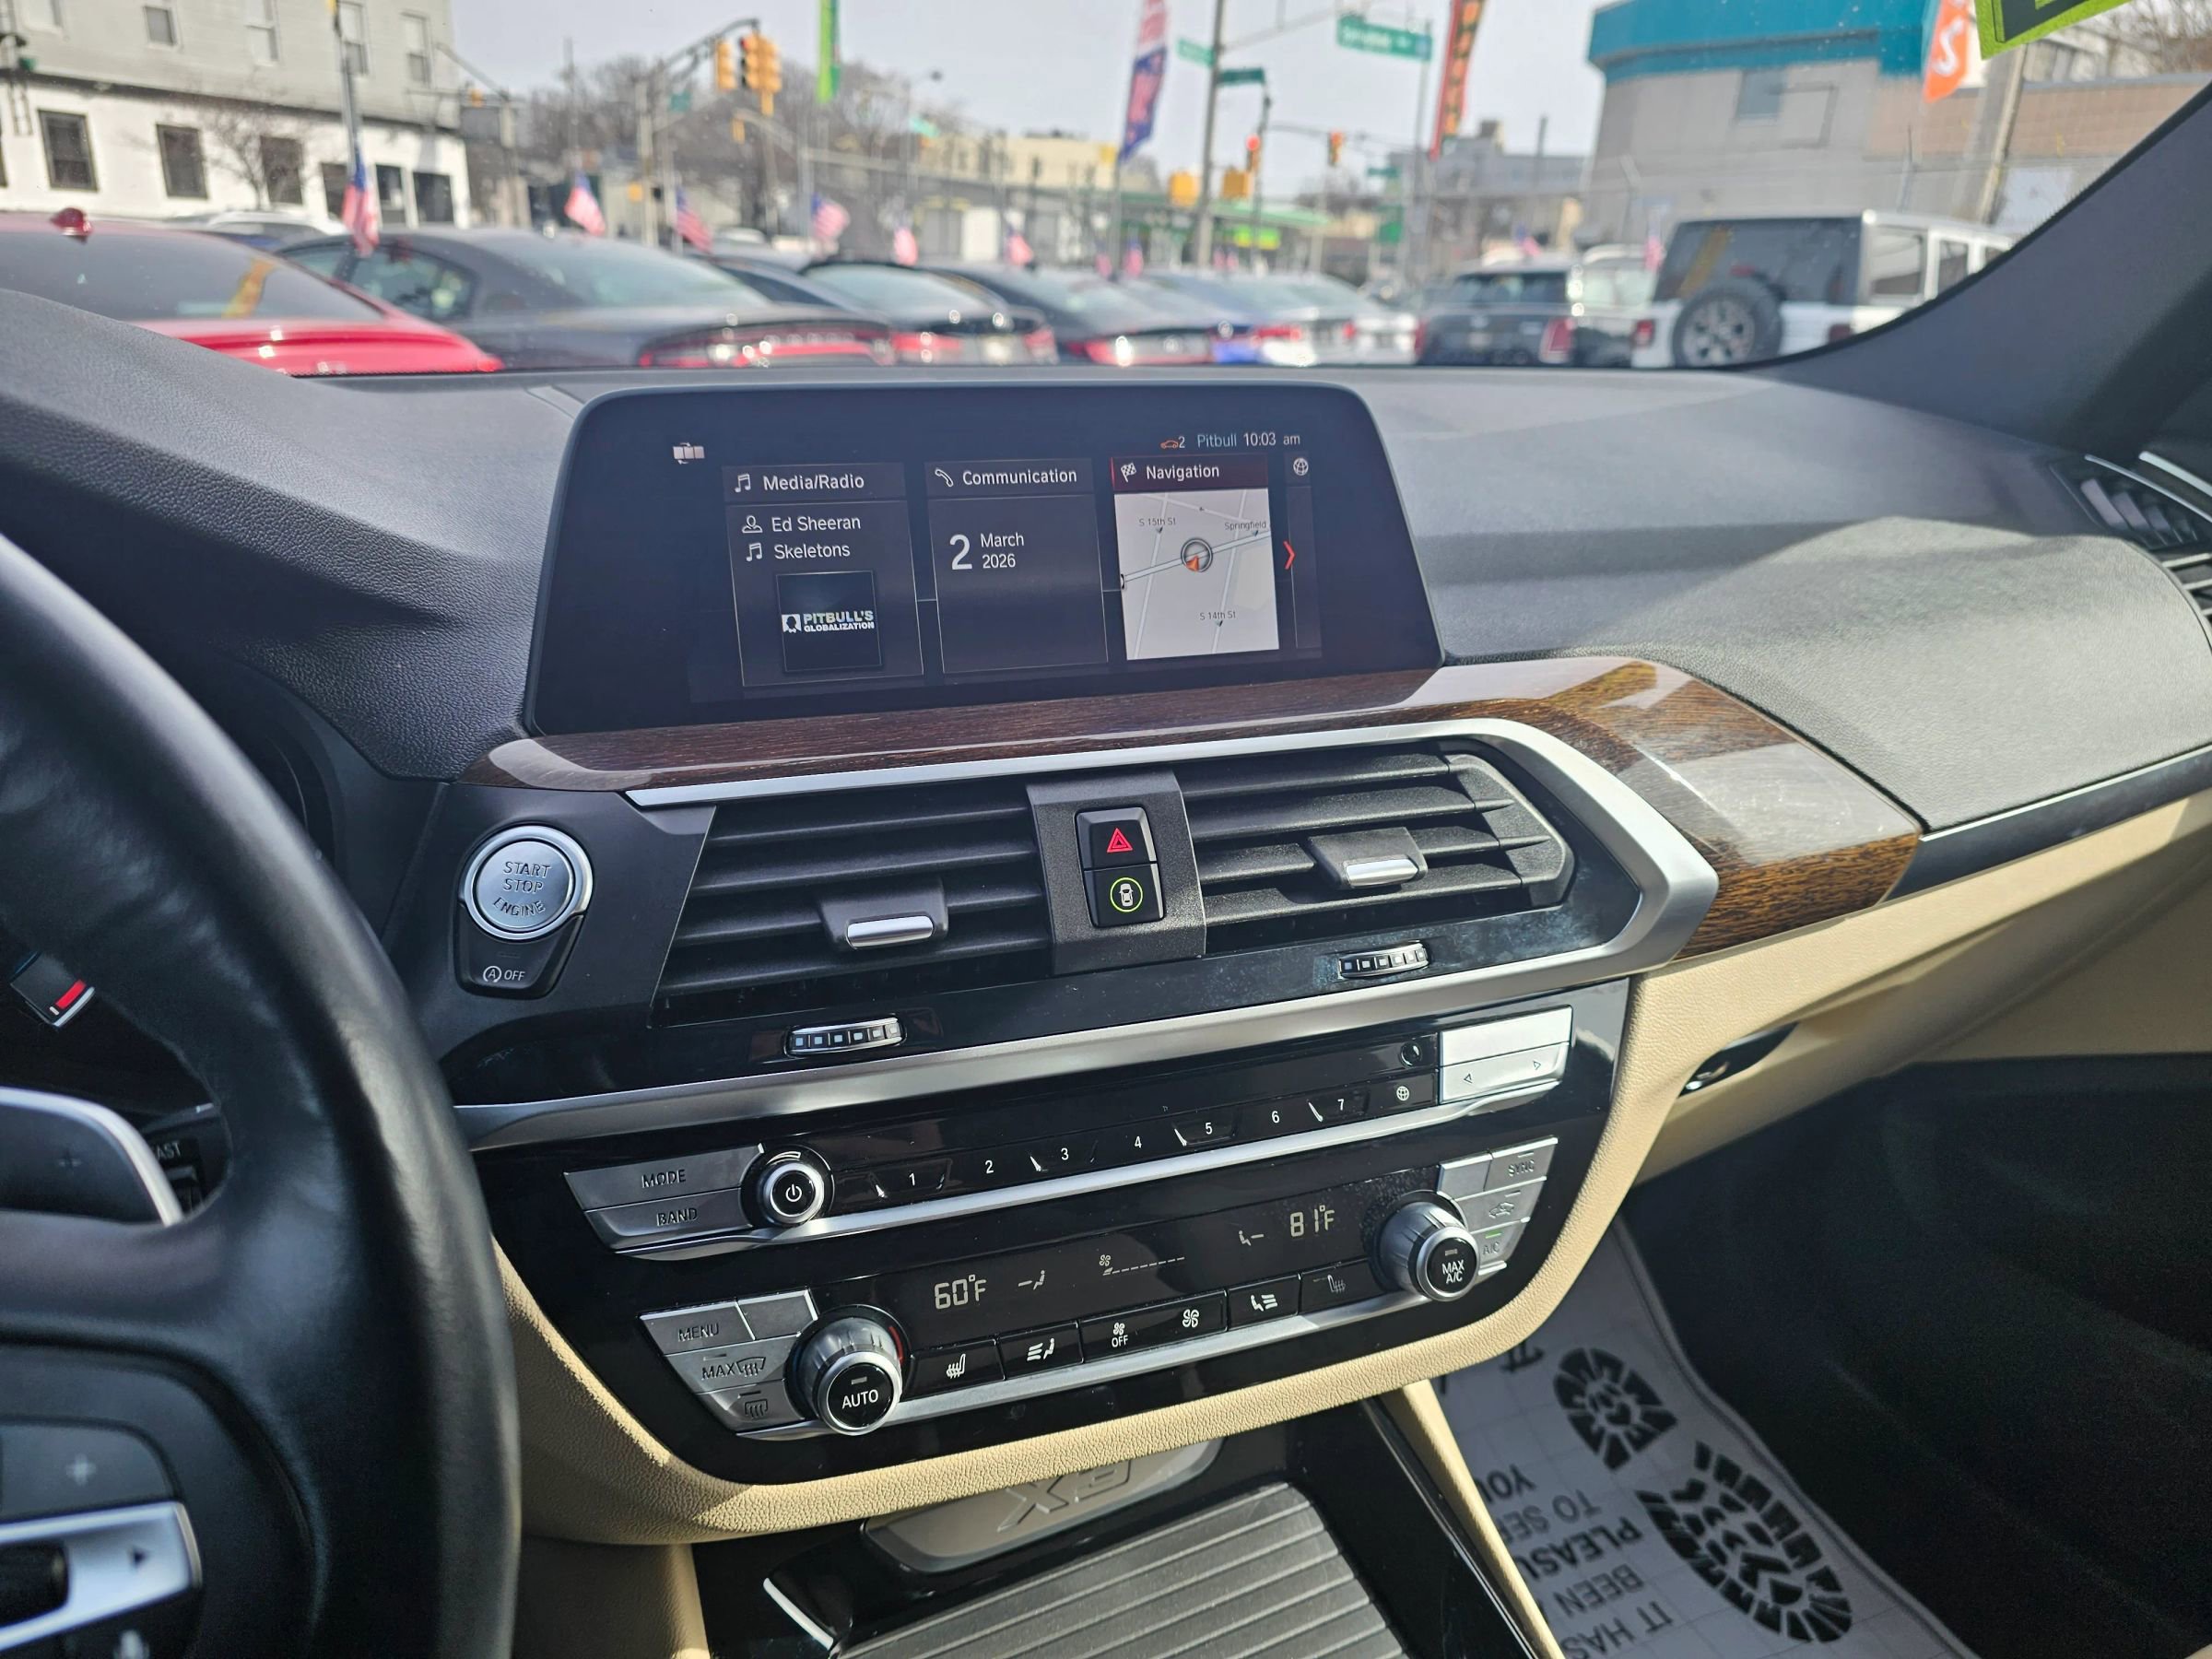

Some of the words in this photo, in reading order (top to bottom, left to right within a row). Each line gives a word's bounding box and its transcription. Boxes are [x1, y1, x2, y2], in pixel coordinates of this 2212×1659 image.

[1178, 436, 1186, 449] 2
[1197, 433, 1238, 448] Pitbull
[1243, 432, 1277, 447] 10:03
[1283, 434, 1301, 445] am
[763, 473, 865, 491] Media/Radio
[962, 468, 1077, 486] Communication
[1146, 465, 1219, 482] Navigation
[771, 517, 793, 532] Ed
[797, 515, 861, 532] Sheeran
[1138, 518, 1145, 527] S
[1147, 517, 1166, 527] 15th
[1168, 517, 1176, 526] St
[1224, 520, 1267, 531] Springfield
[980, 531, 1025, 547] March
[773, 542, 851, 559] Skeletons
[949, 534, 973, 571] 2
[982, 553, 1016, 569] 2026
[803, 610, 874, 624] PITBULL'S
[1199, 612, 1206, 620] S
[1208, 611, 1226, 620] 14th
[1228, 610, 1236, 619] St
[804, 621, 875, 632] GLOBALIZATION
[503, 861, 551, 878] START
[502, 878, 544, 894] STOP
[492, 897, 547, 917] ENGINE
[503, 970, 525, 982] OFF
[152, 1140, 182, 1160] AST
[908, 1172, 916, 1186] 1
[984, 1159, 994, 1174] 2
[1060, 1147, 1069, 1161] 3
[1134, 1135, 1143, 1149] 4
[1205, 1122, 1213, 1135] 5
[1271, 1110, 1280, 1124] 6
[1337, 1099, 1346, 1112] 7
[641, 1169, 687, 1189] MODE
[656, 1207, 698, 1227] BAND
[1483, 1241, 1500, 1256] A/C
[1441, 1259, 1465, 1275] MAX
[1445, 1271, 1464, 1285] A/C
[677, 1322, 720, 1342] MENU
[1111, 1335, 1129, 1348] OFF
[701, 1361, 736, 1381] MAX
[841, 1388, 879, 1410] AUTO
[1550, 1488, 1603, 1524] TO
[1552, 1562, 1645, 1618] BEEN
[1635, 1599, 1675, 1633] IT
